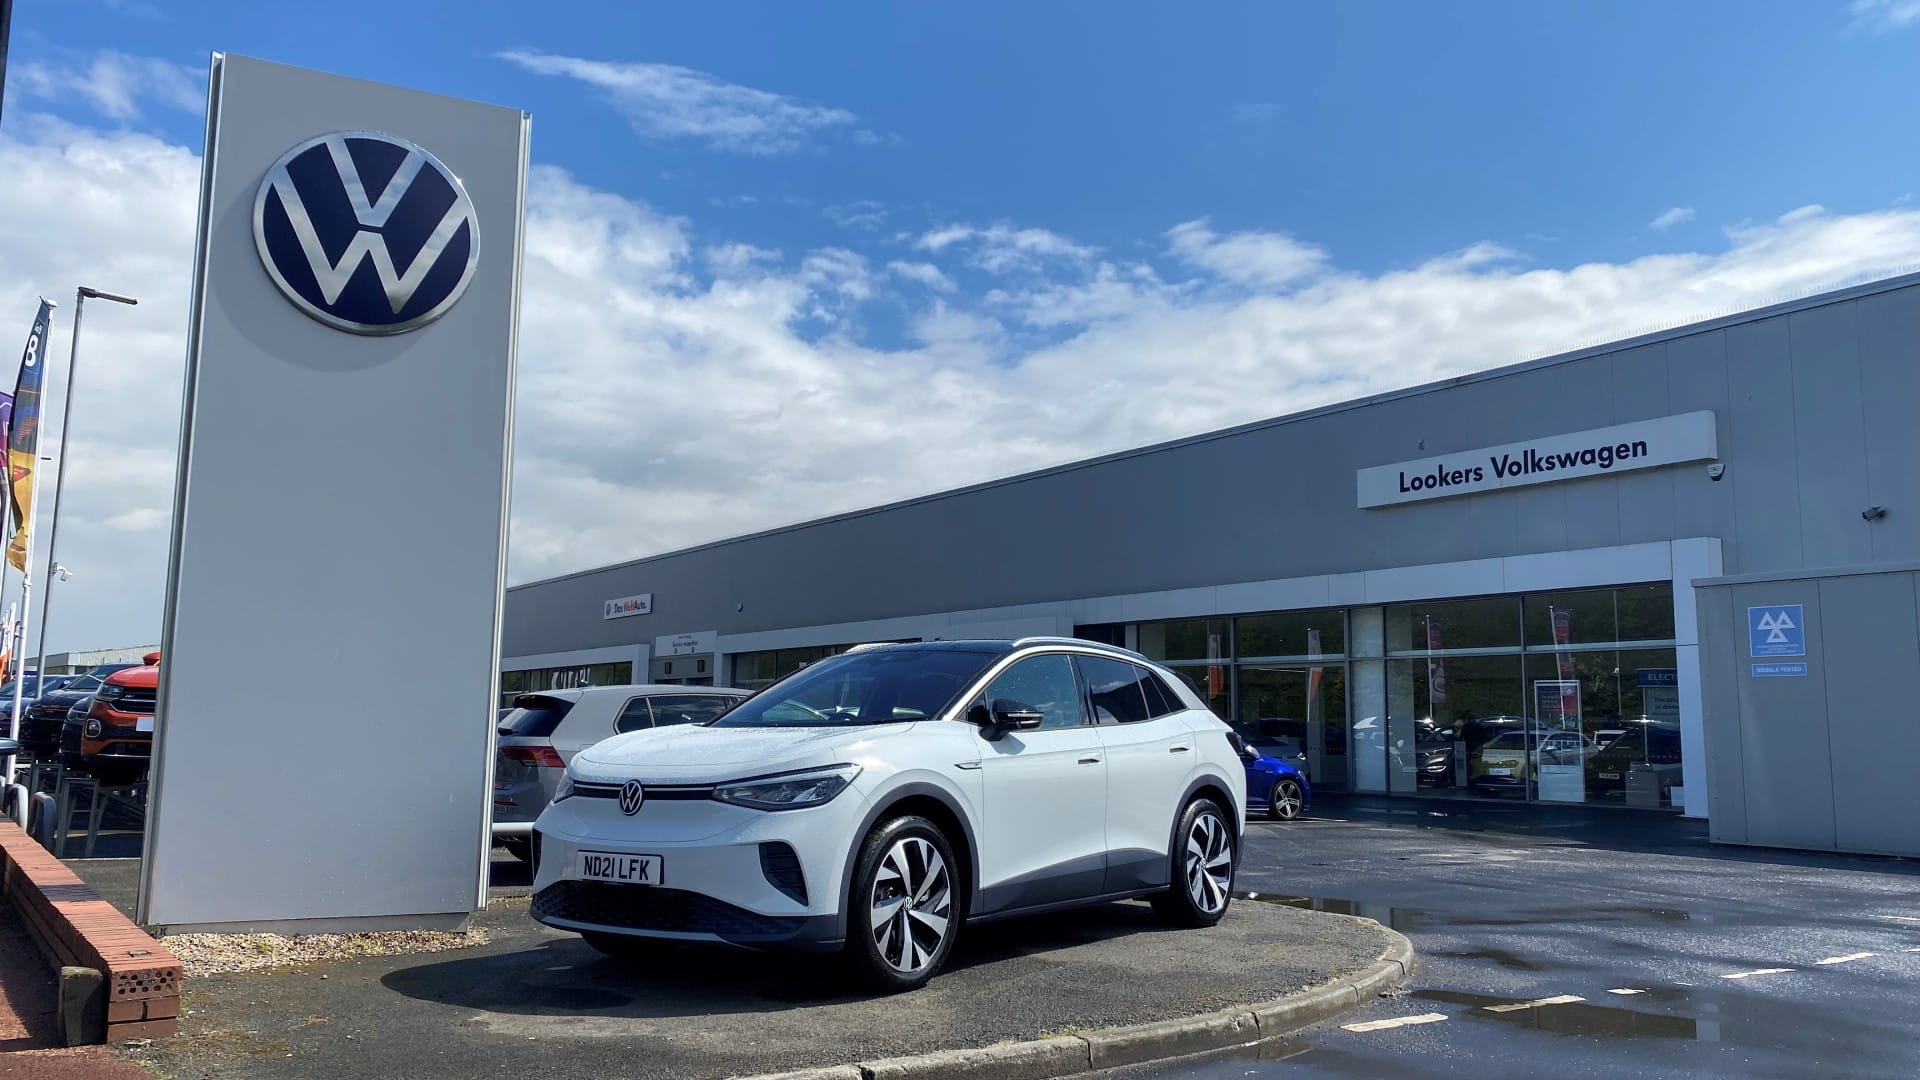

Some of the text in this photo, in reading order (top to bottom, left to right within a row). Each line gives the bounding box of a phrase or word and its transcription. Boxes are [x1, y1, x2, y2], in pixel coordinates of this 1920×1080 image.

[259, 135, 473, 322] VW
[1400, 440, 1647, 493] Lookers Volkswagen
[1648, 673, 1678, 681] ELECT
[584, 856, 649, 880] ND21 LFK
